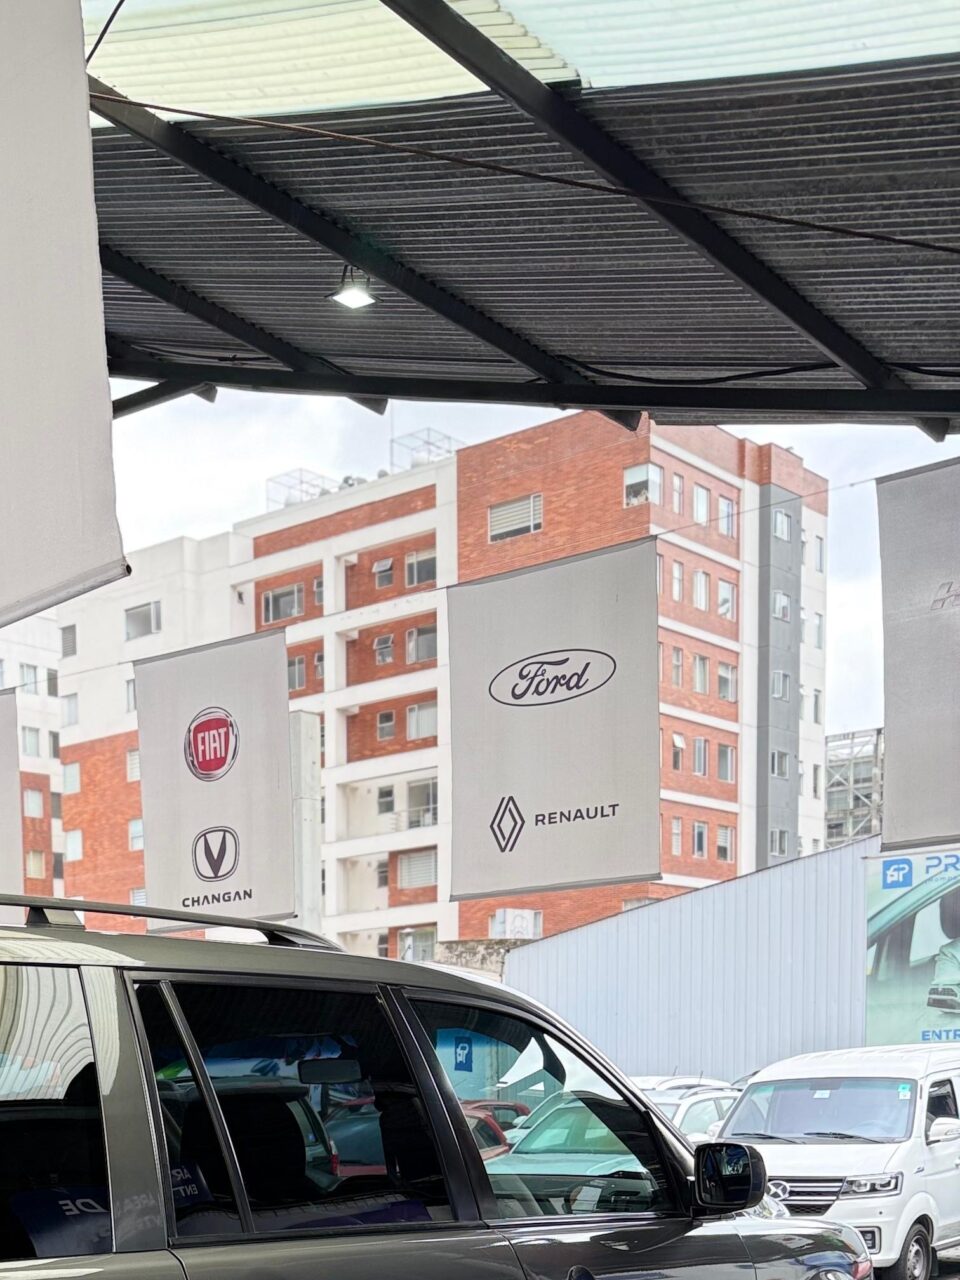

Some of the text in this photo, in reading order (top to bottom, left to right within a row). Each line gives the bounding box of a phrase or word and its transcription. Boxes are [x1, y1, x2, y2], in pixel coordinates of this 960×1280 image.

[511, 657, 592, 700] Ford
[197, 727, 228, 762] FIAT
[534, 803, 620, 827] RENAULT
[181, 888, 253, 908] CHANGAN
